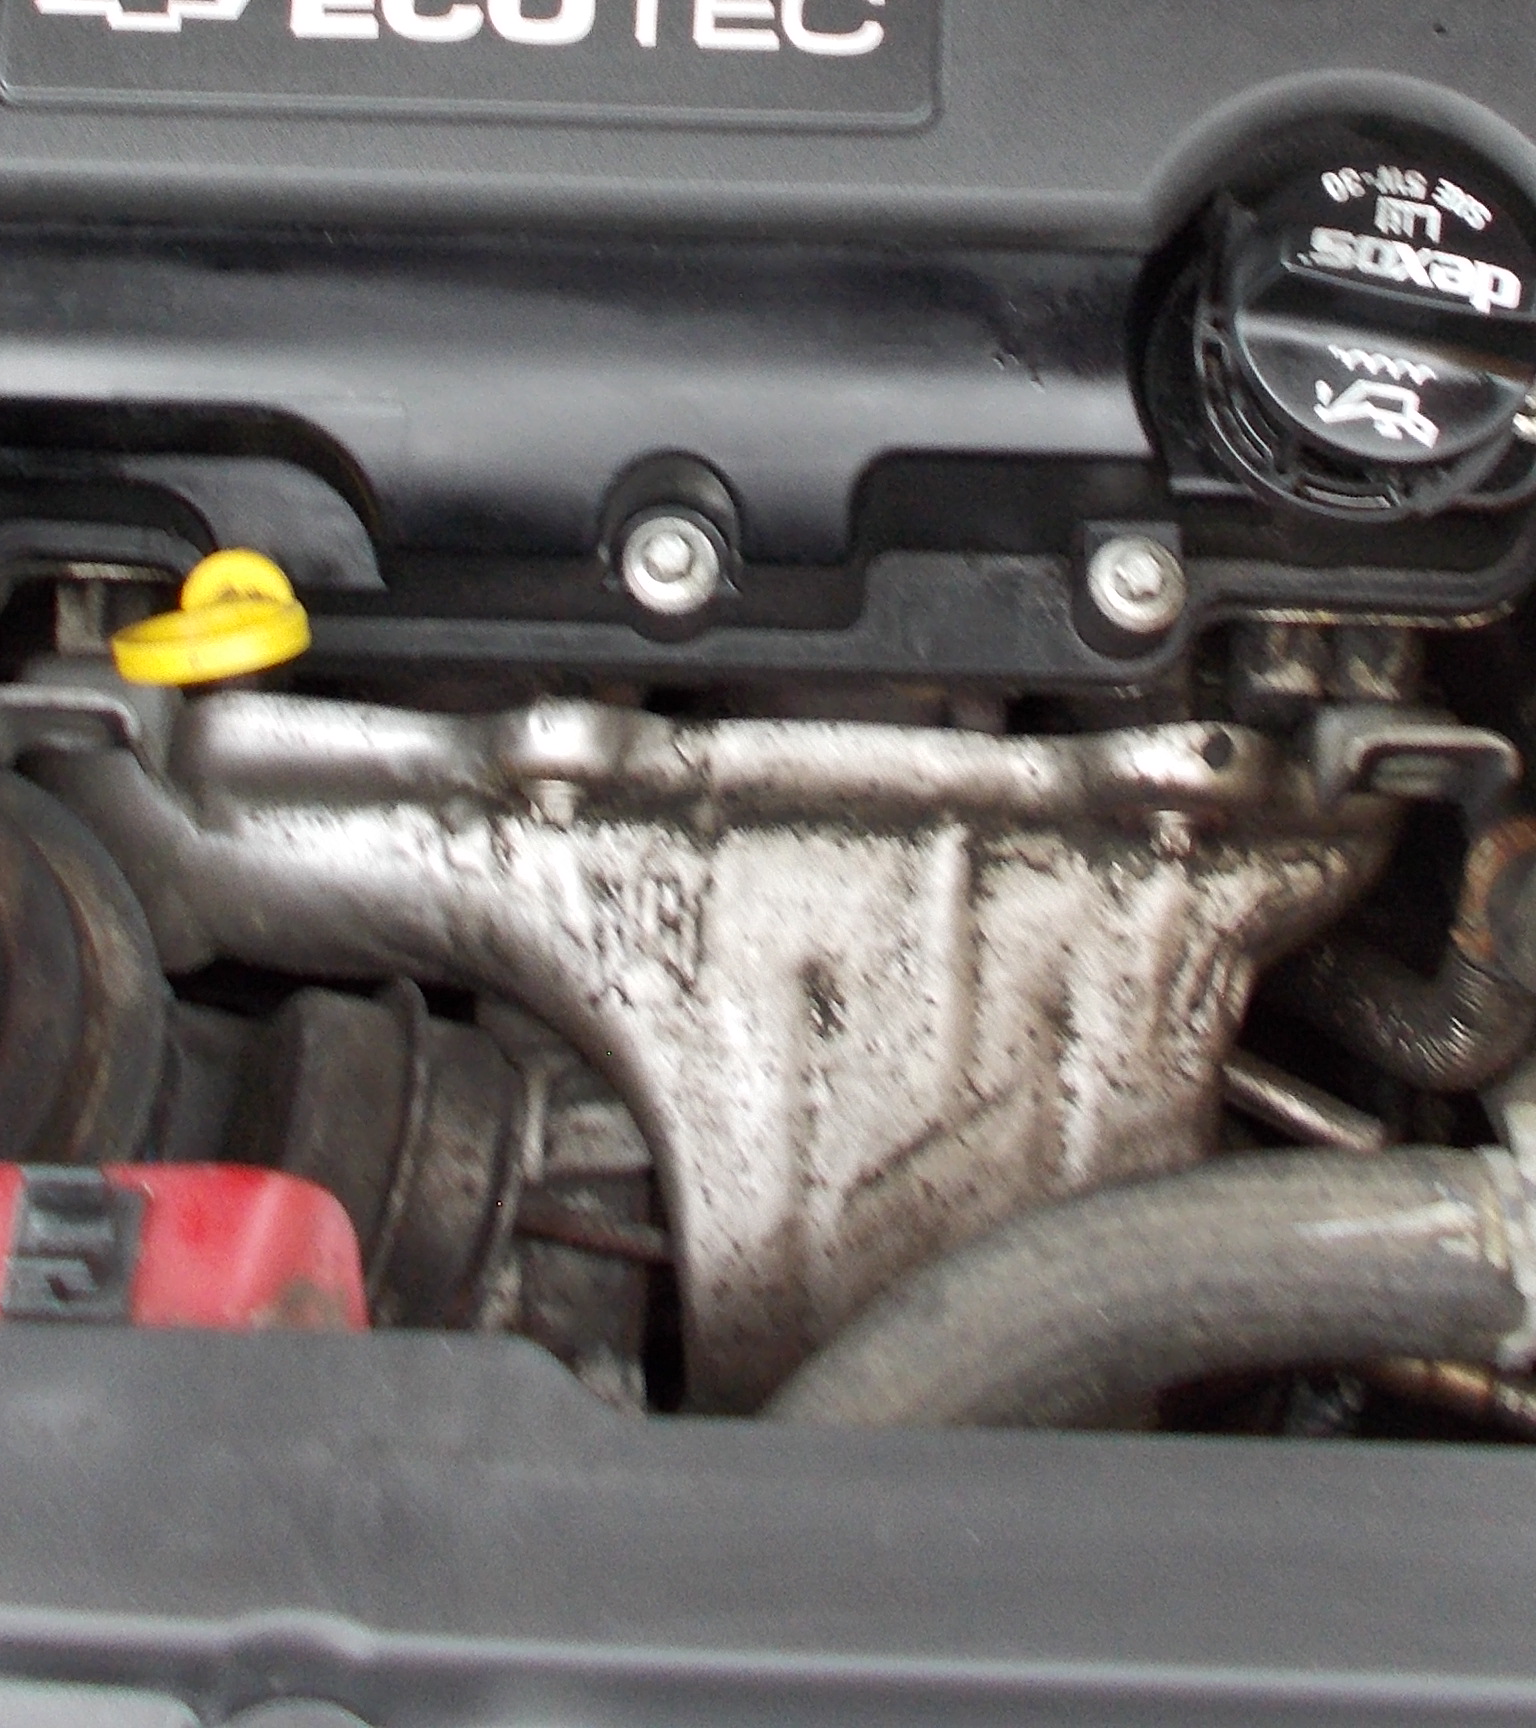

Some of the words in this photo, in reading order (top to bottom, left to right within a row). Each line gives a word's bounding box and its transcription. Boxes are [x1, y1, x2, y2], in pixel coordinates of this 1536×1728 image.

[1321, 166, 1428, 203] 5W-30
[1431, 177, 1492, 231] SAE
[1309, 227, 1522, 314] dexos
